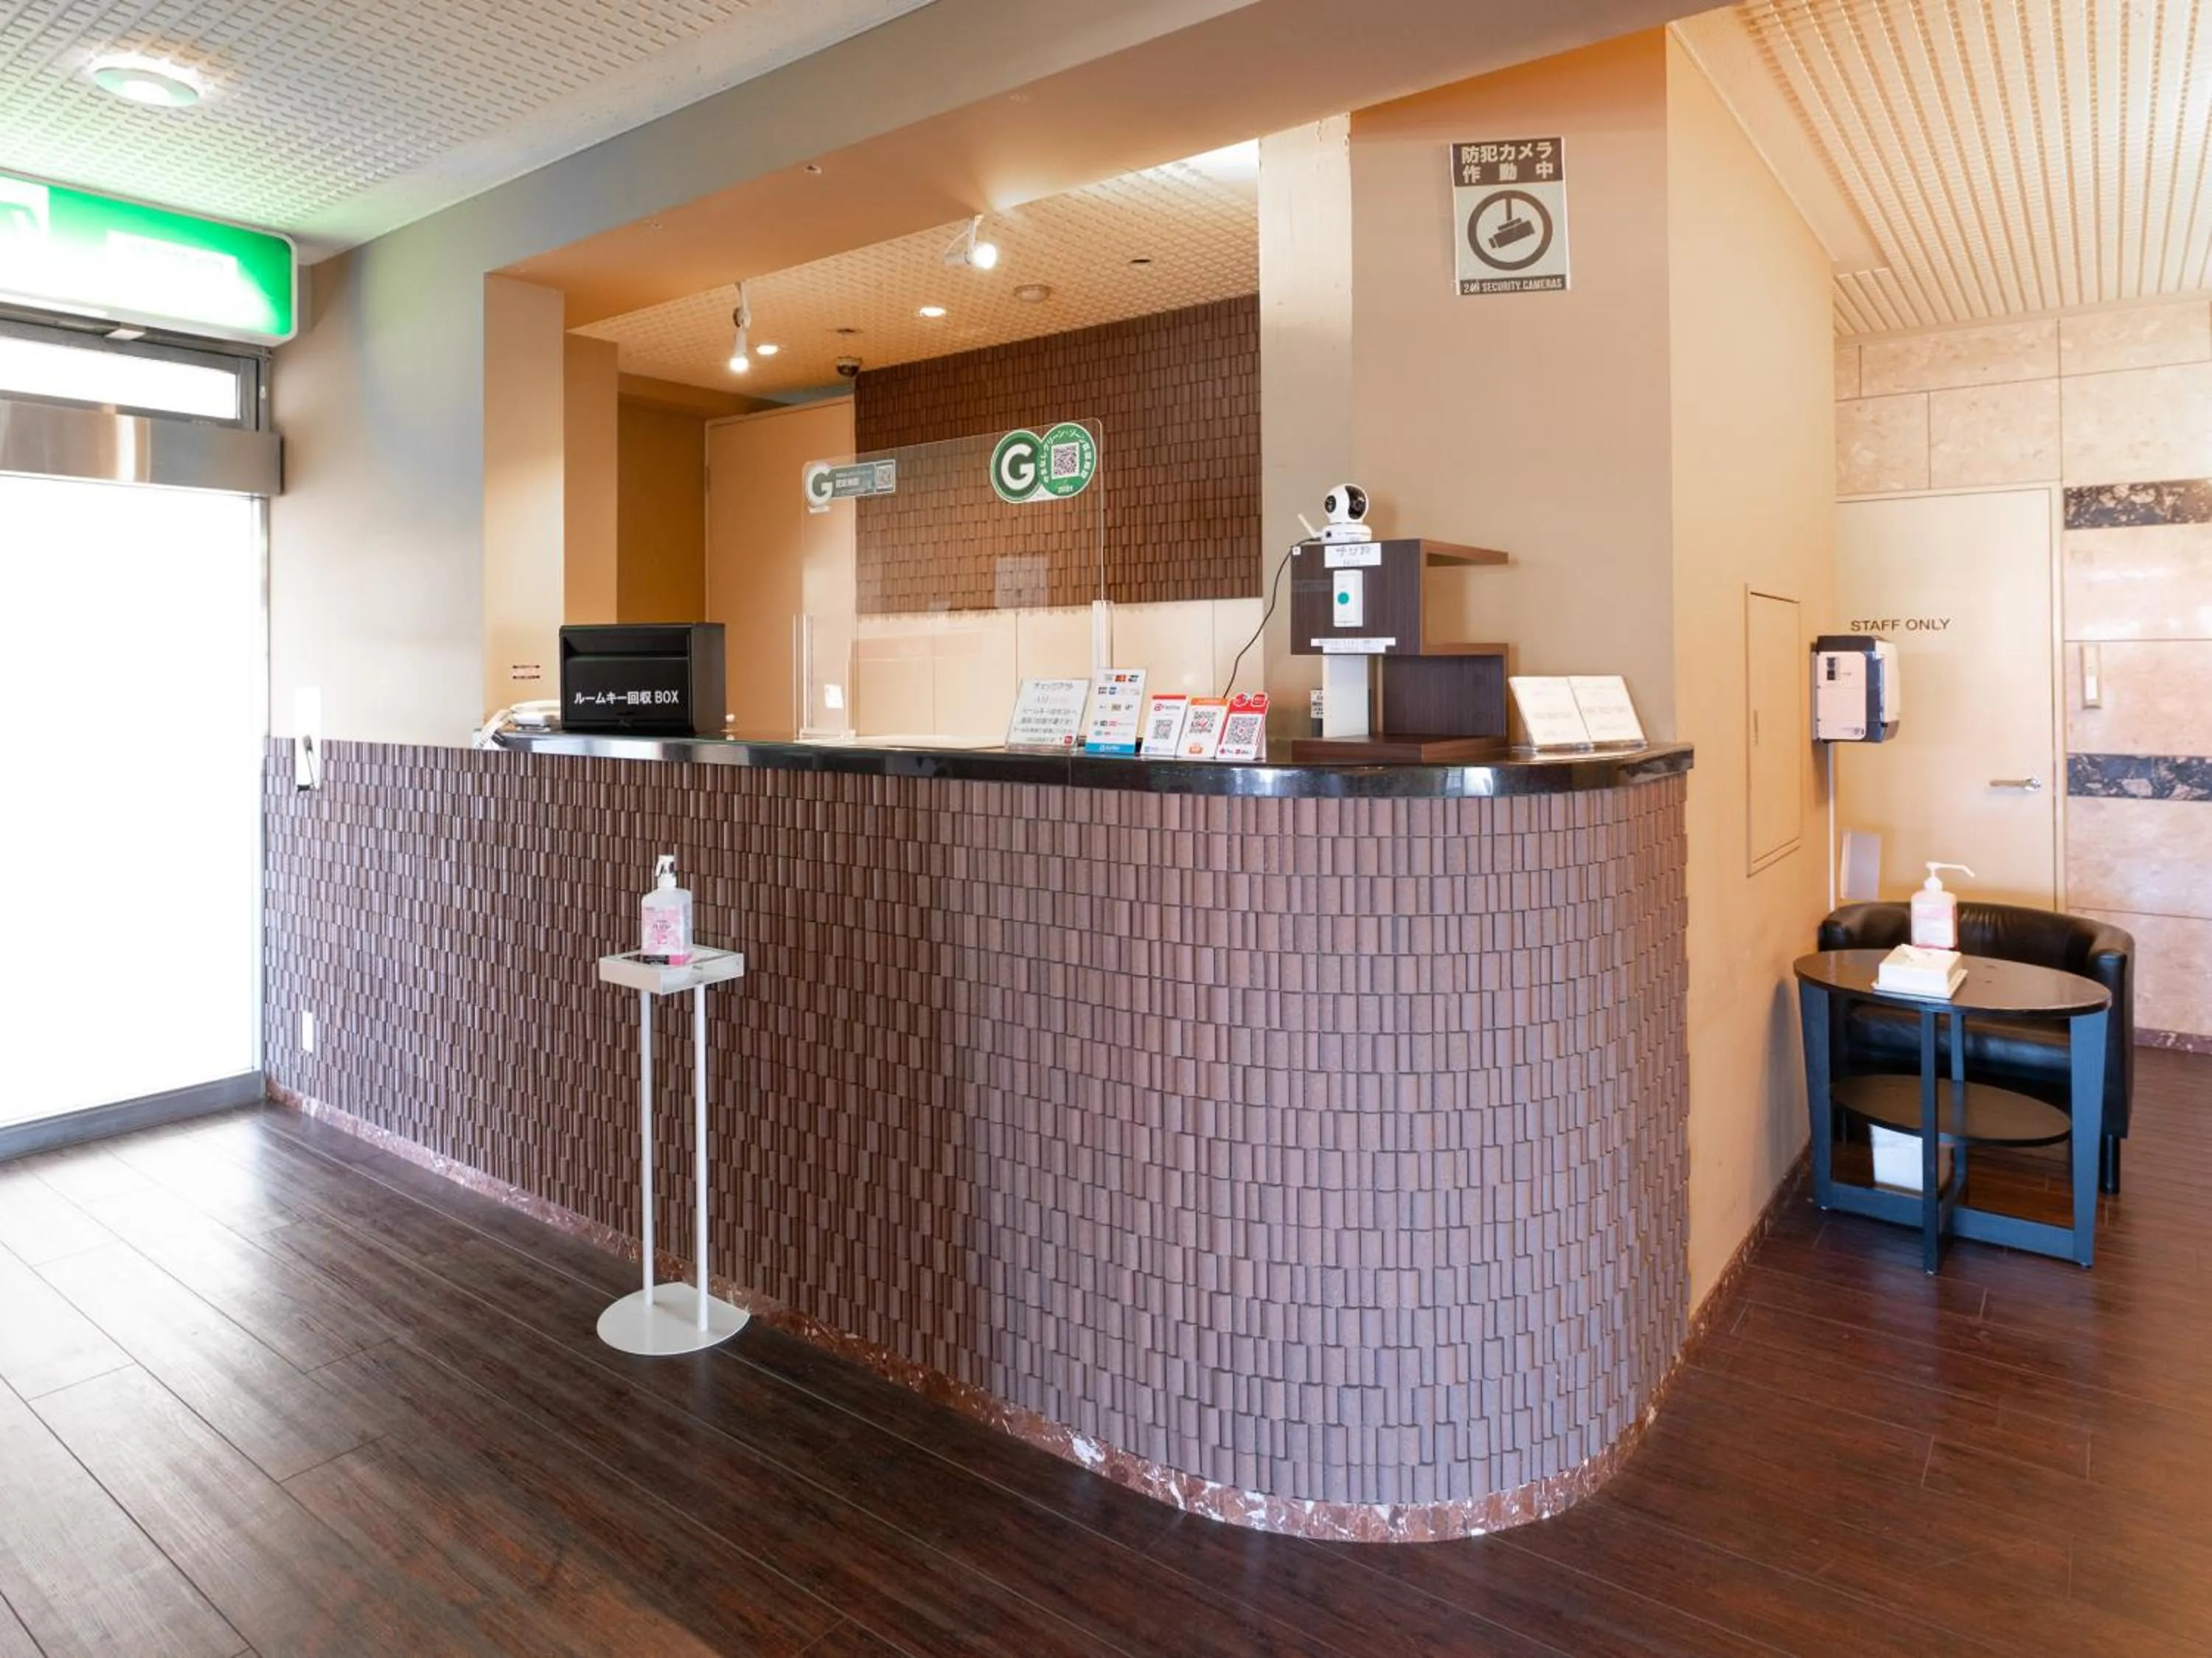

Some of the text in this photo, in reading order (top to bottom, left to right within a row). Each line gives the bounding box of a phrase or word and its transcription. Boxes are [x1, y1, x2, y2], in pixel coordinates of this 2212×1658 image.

[1461, 141, 1553, 164] 防犯カメラ
[1462, 161, 1554, 184] 作動中
[1481, 280, 1521, 293] SECURITY
[1523, 277, 1563, 290] CAMERAS
[1000, 443, 1035, 491] G
[807, 466, 833, 502] G
[1851, 618, 1951, 632] STAFF ONLY
[574, 690, 679, 705] ルームキー回収 BOX
